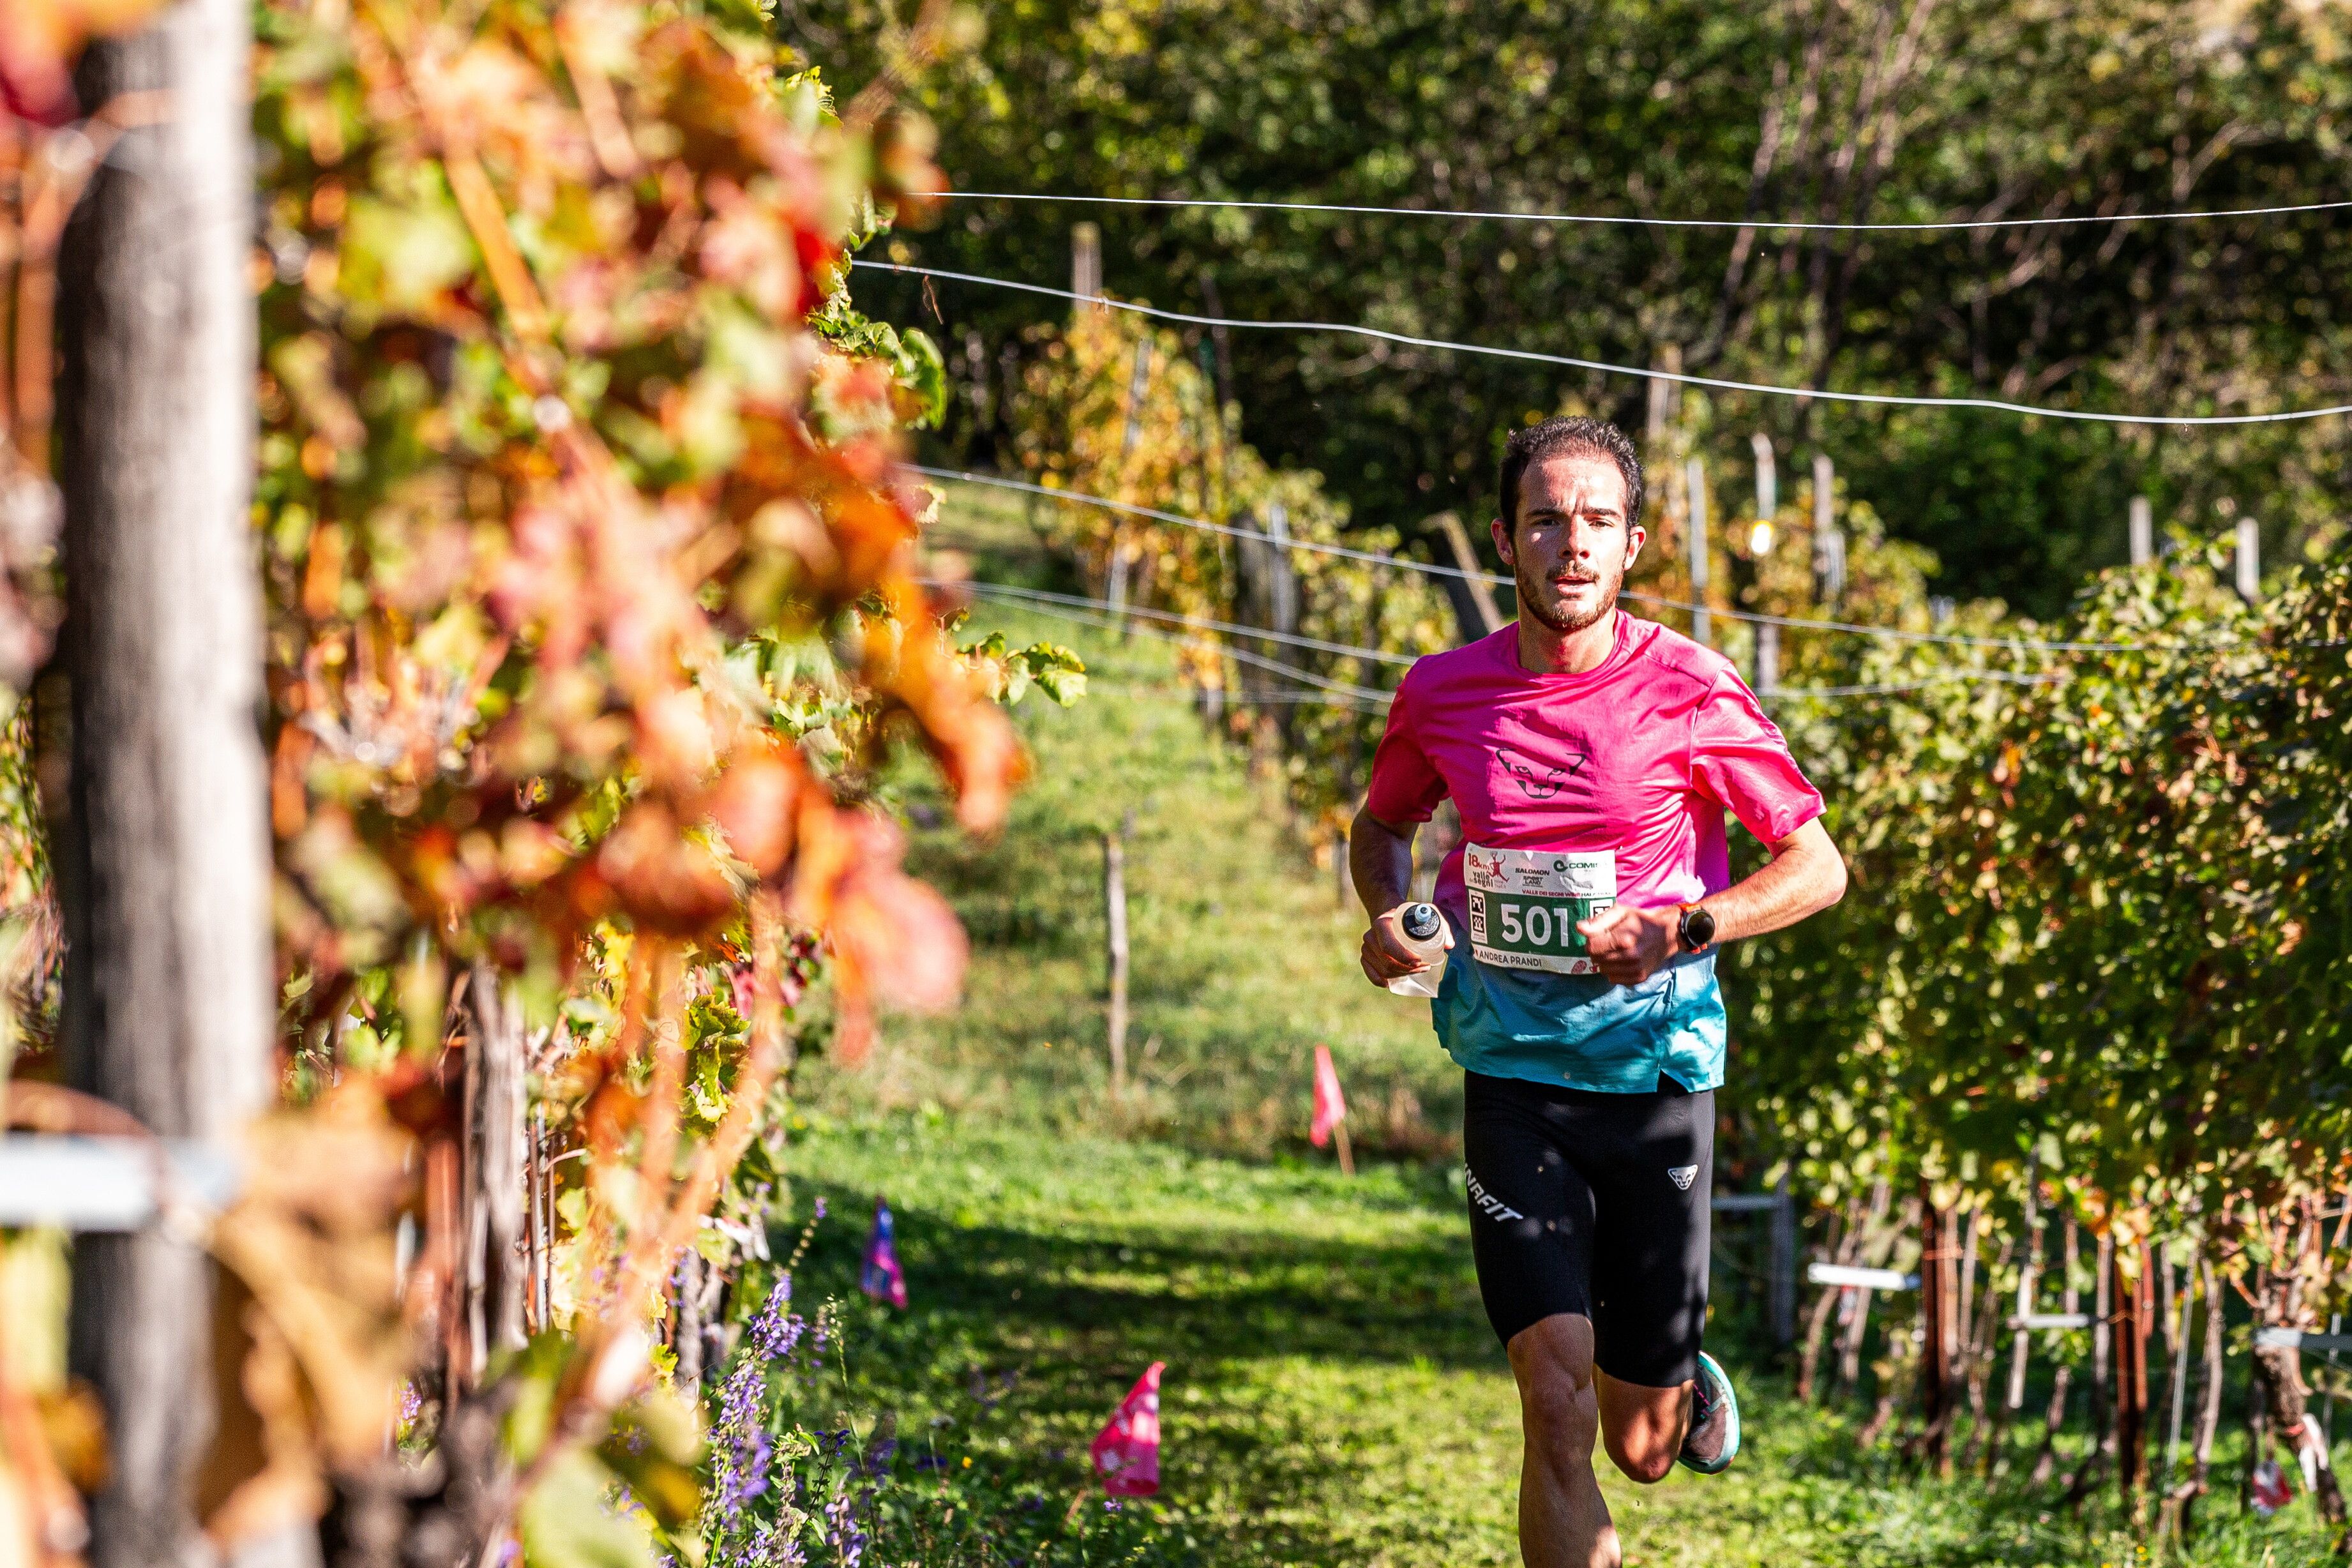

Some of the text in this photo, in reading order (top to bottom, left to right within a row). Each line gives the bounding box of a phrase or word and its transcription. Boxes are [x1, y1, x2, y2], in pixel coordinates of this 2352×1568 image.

[1515, 867, 1550, 876] SALOMON
[1501, 903, 1569, 947] 501
[1479, 950, 1542, 967] ANDREA PRANDI
